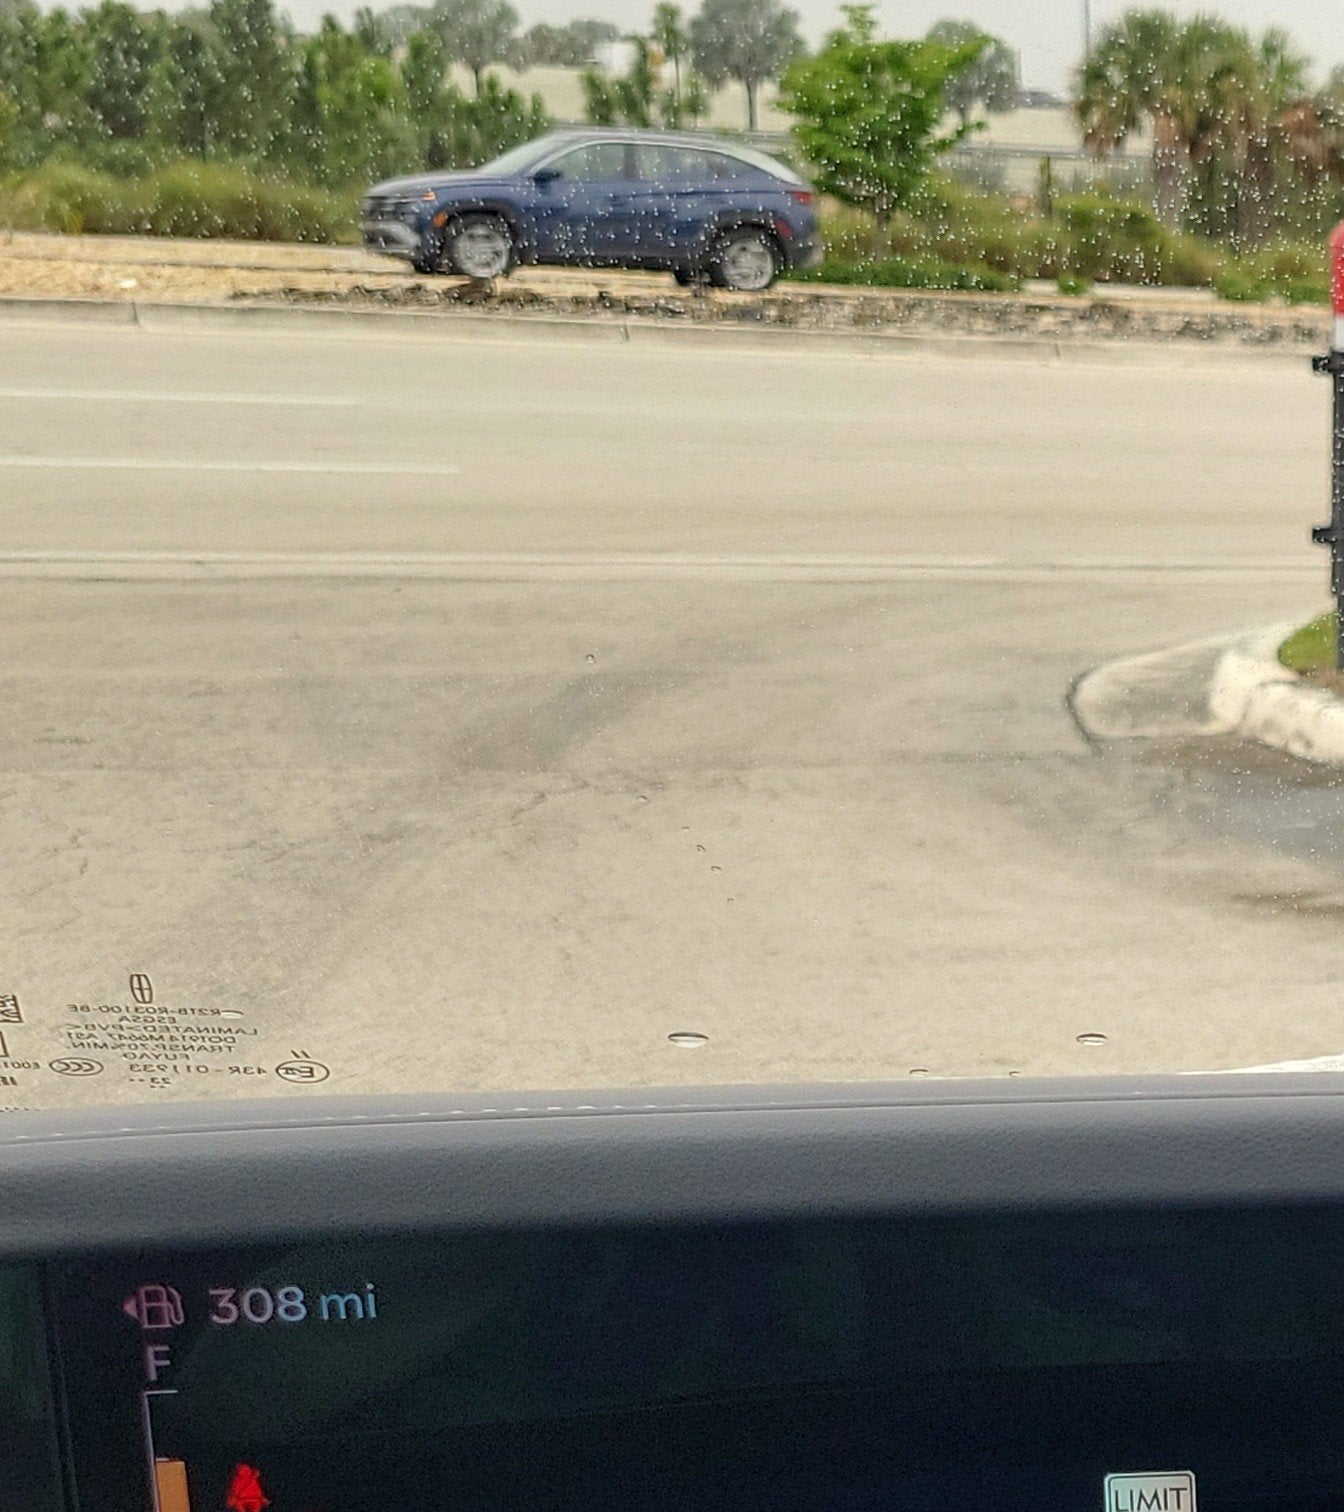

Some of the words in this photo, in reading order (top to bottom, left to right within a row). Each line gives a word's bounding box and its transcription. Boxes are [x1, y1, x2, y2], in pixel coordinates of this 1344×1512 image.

[209, 1286, 308, 1324] 308
[320, 1283, 377, 1320] mi
[146, 1345, 171, 1381] F
[1114, 1487, 1188, 1512] LIMIT
